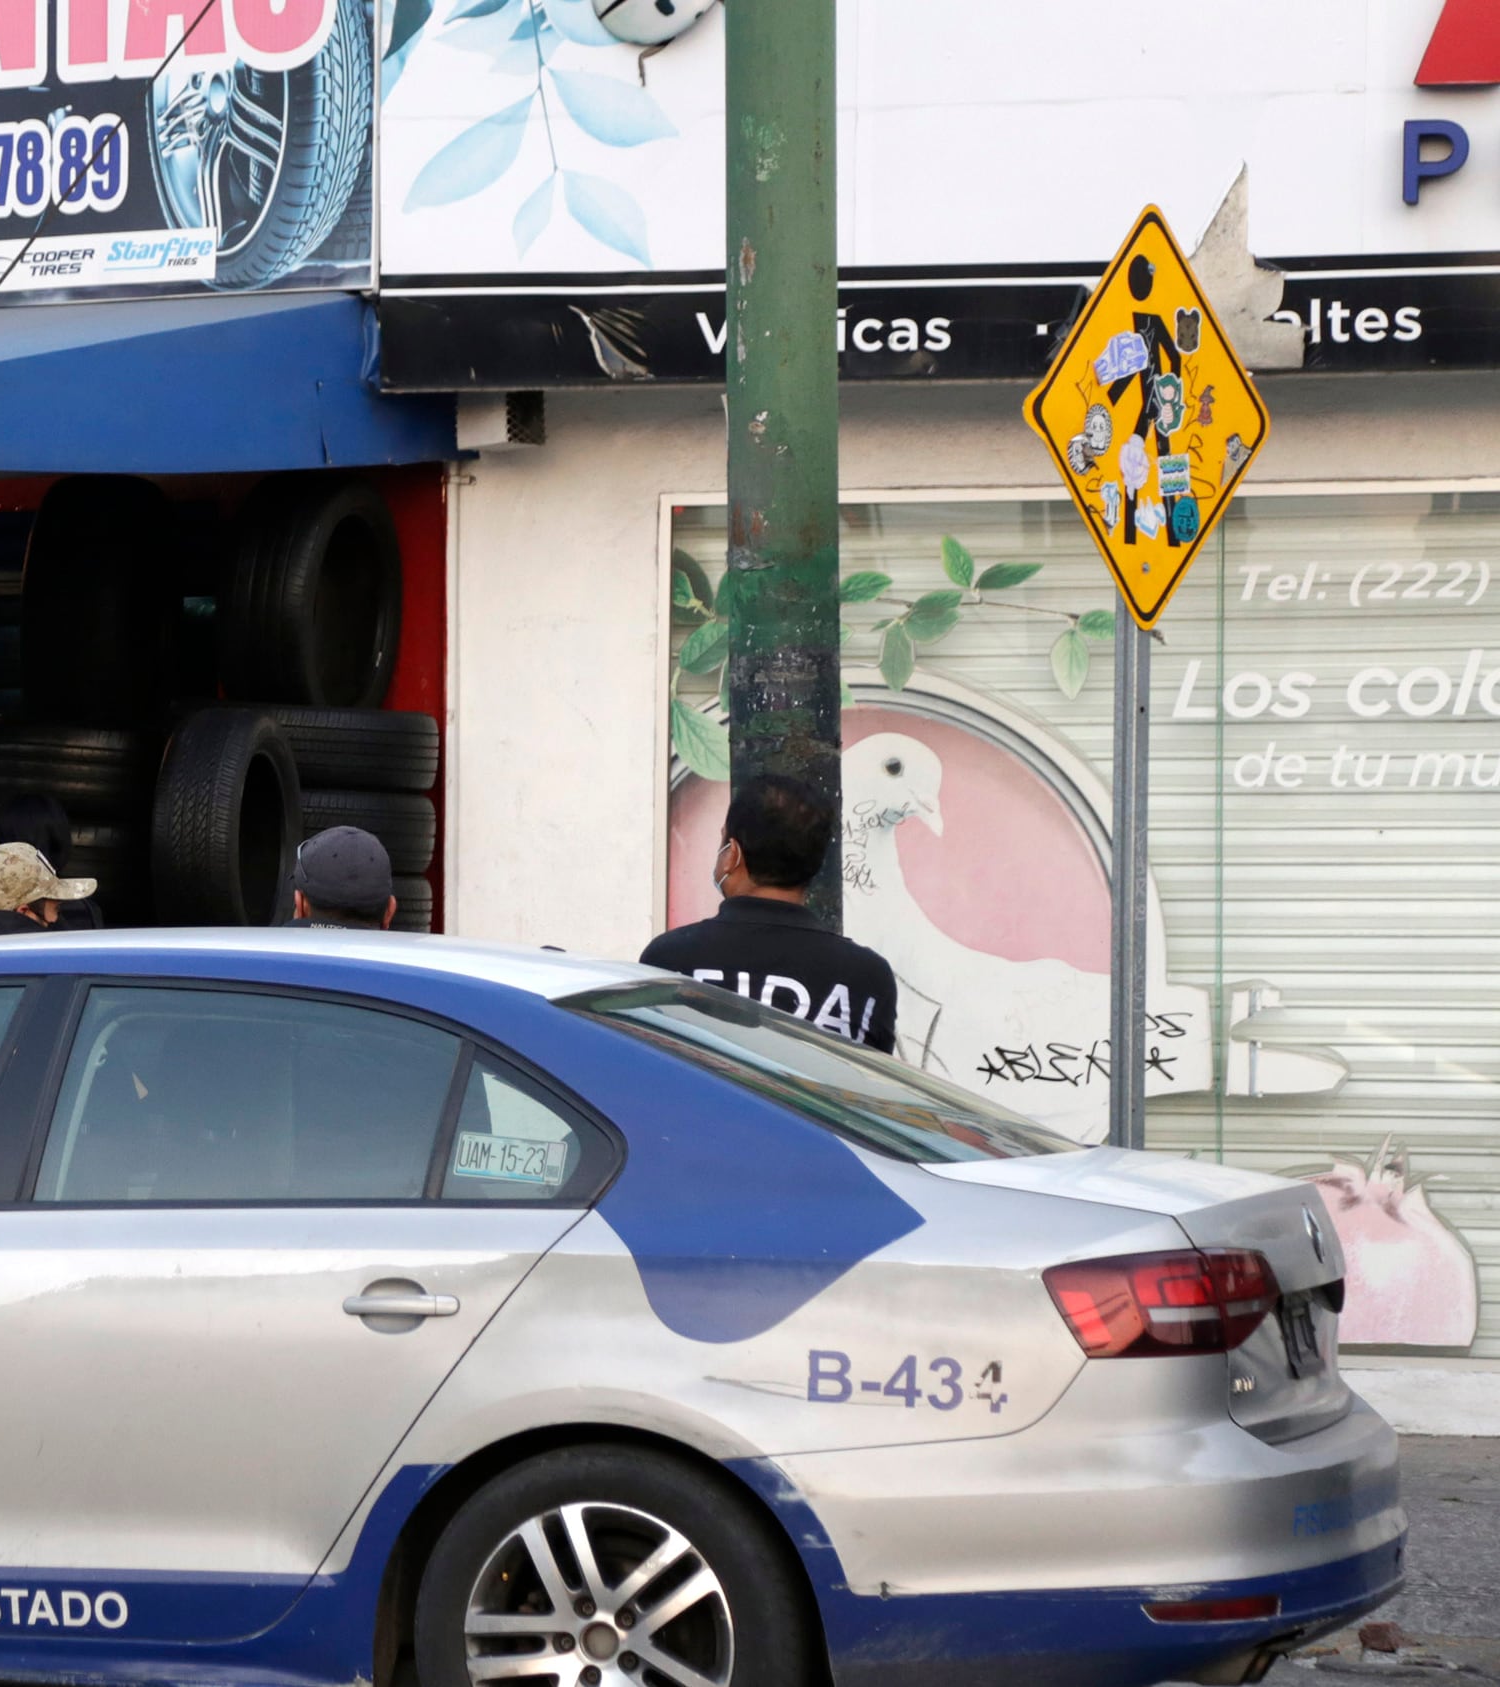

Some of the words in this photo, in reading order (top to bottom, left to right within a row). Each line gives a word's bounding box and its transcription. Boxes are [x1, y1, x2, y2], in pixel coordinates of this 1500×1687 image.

[58, 124, 121, 202] 89
[20, 248, 95, 264] COOPER
[30, 263, 82, 277] TIRES
[106, 237, 213, 268] Starfire
[167, 257, 198, 267] TIRES
[1238, 560, 1331, 601] Tel:
[1349, 560, 1491, 607] (222)
[1171, 659, 1318, 719] Los
[1232, 741, 1309, 788] de
[1330, 744, 1391, 788] tu
